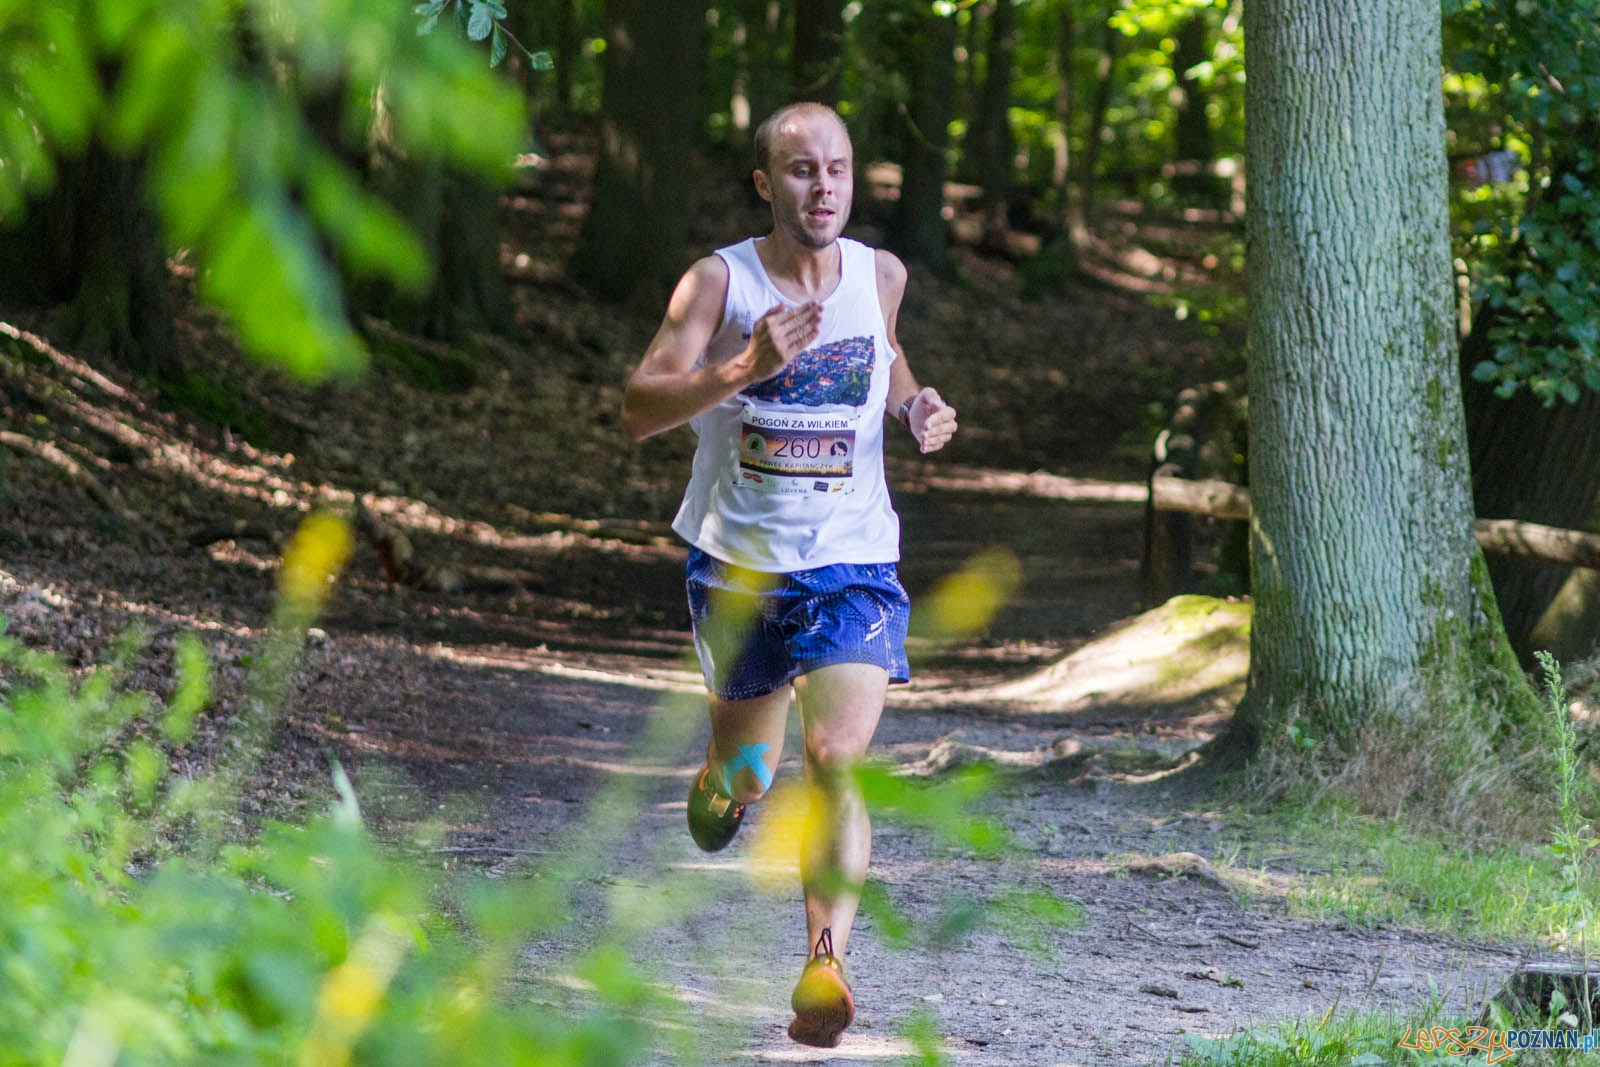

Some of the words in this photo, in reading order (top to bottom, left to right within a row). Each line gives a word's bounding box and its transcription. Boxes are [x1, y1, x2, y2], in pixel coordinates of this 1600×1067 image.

[791, 420, 805, 429] ZA
[807, 420, 848, 429] WILKIEM
[773, 436, 821, 459] 260
